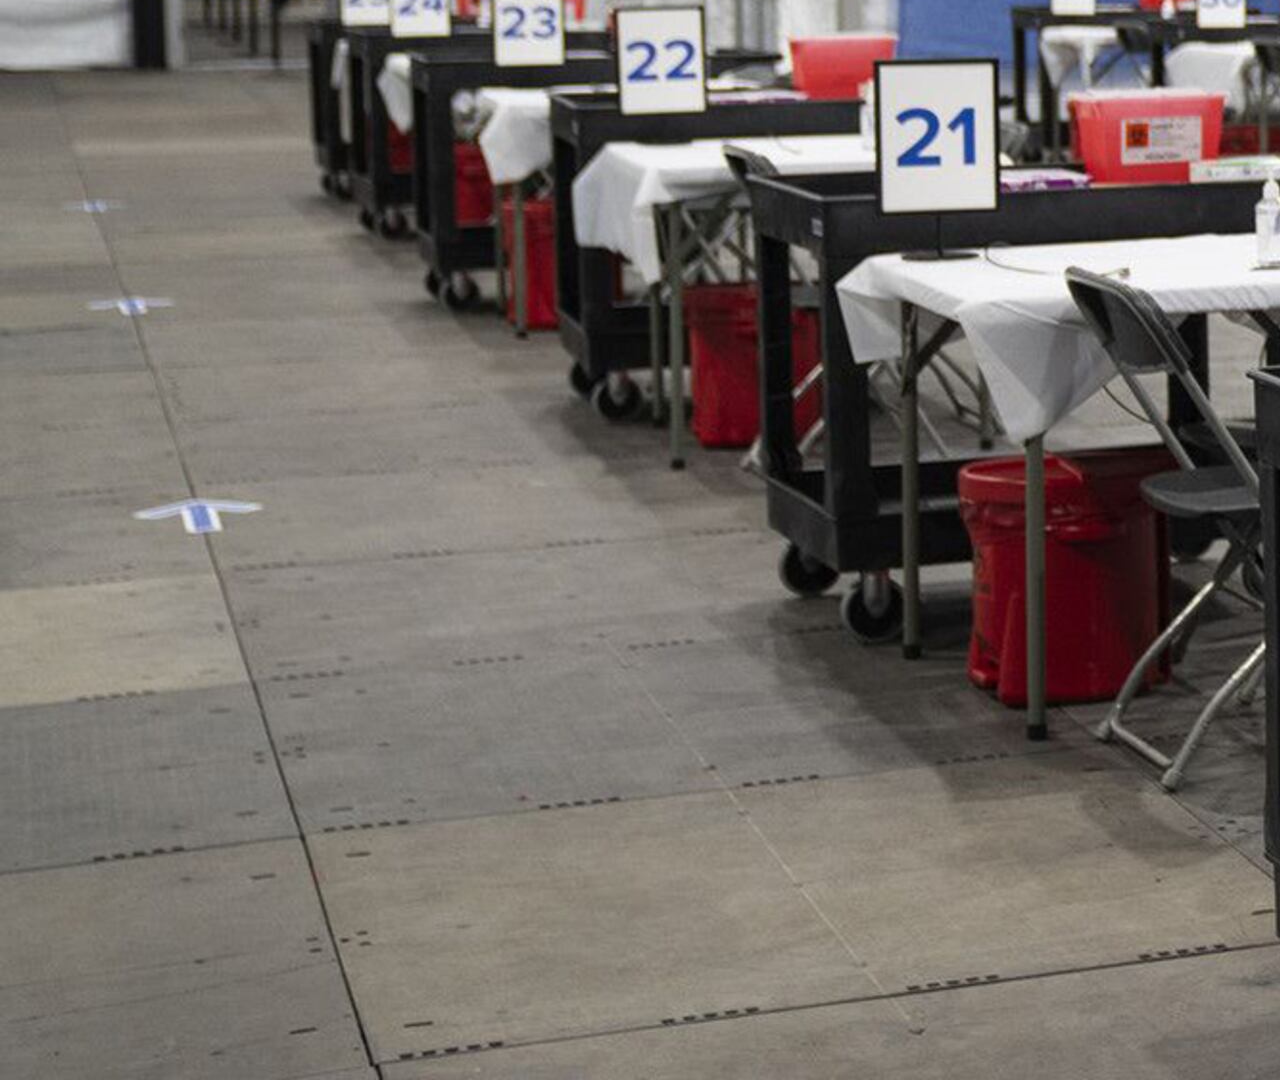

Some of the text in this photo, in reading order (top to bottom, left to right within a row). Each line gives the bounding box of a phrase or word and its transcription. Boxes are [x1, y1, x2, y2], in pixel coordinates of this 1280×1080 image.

[502, 7, 556, 39] 23
[626, 39, 697, 82] 22
[895, 106, 978, 168] 21
